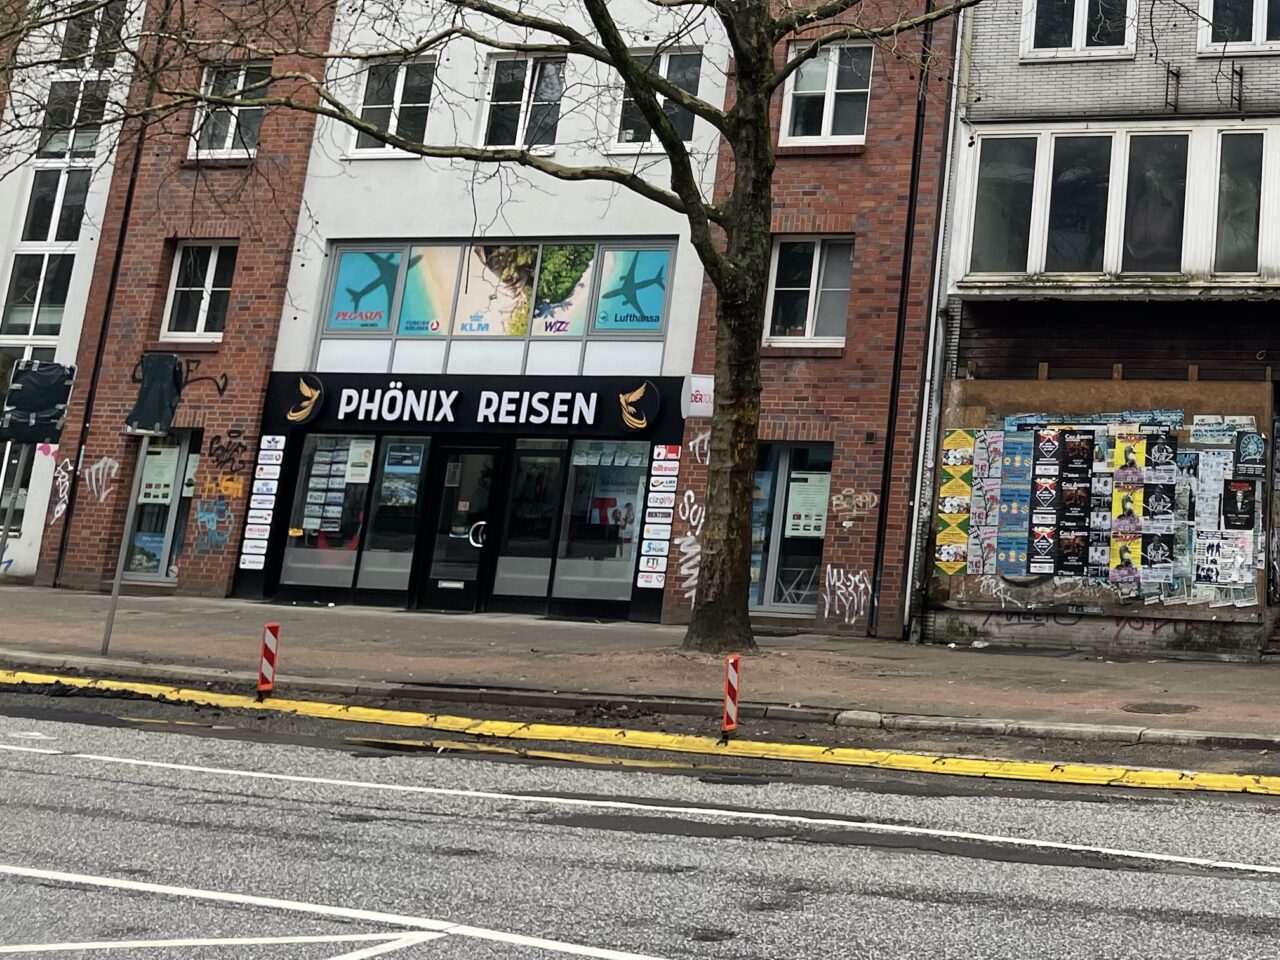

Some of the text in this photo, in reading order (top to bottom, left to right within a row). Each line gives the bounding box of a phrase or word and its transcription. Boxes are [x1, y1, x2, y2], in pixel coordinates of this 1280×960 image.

[335, 311, 383, 321] PEGASUS
[614, 313, 660, 323] Lufthansa
[460, 323, 489, 332] KLM
[544, 321, 570, 333] WIZZ
[337, 381, 598, 425] PHÖNIX REISEN
